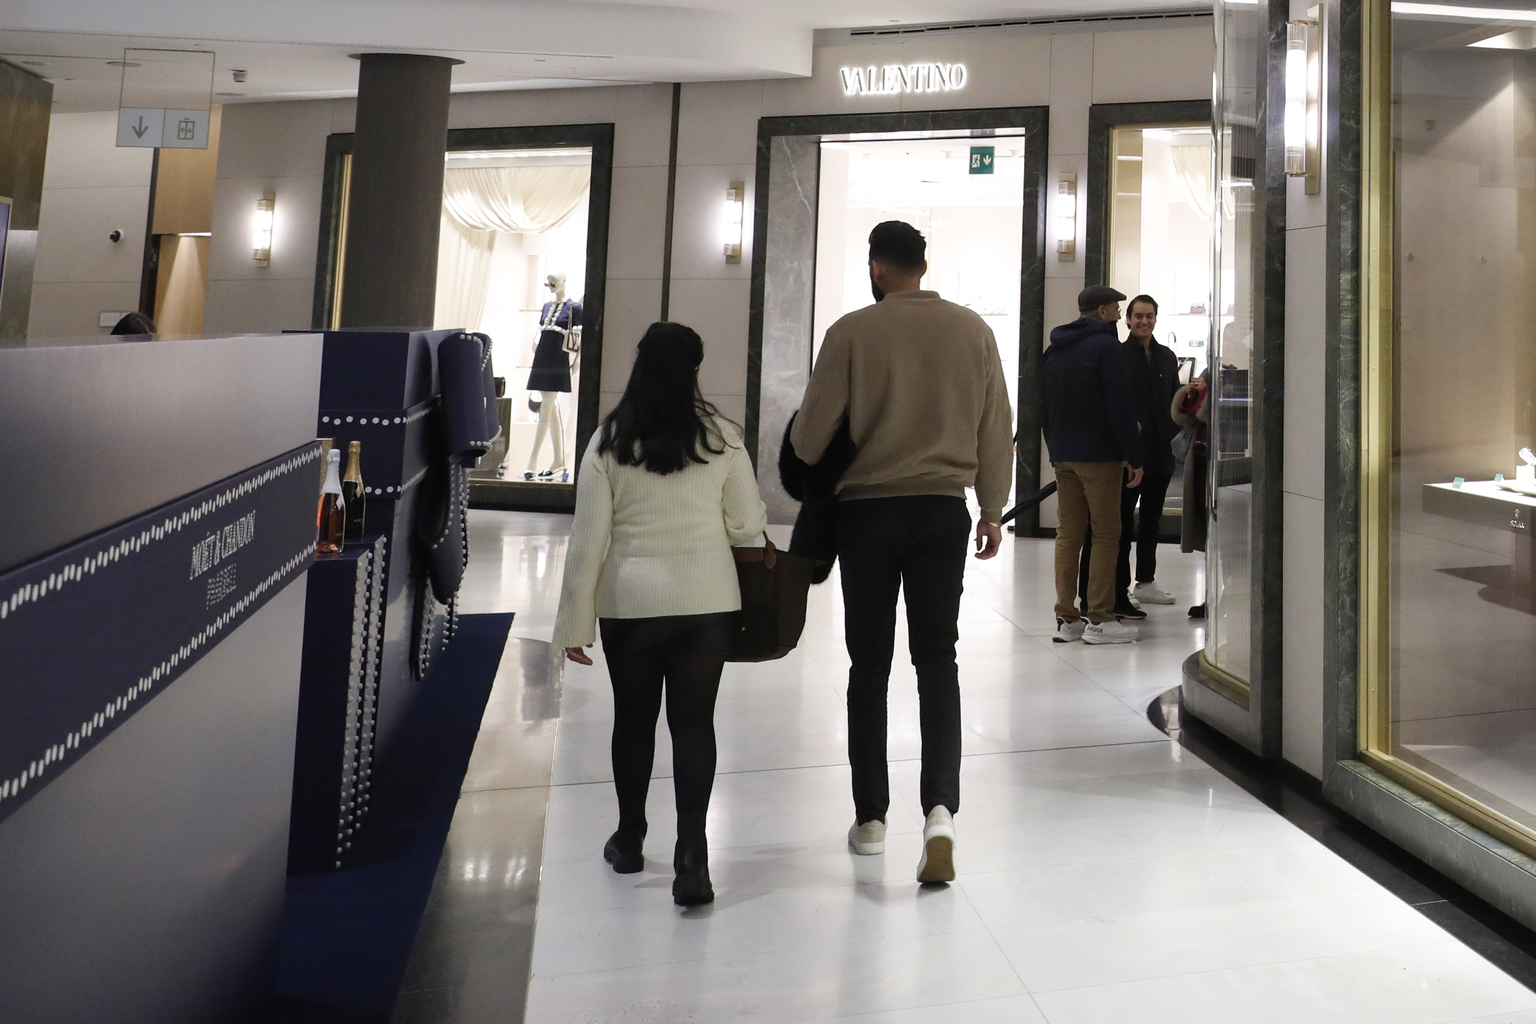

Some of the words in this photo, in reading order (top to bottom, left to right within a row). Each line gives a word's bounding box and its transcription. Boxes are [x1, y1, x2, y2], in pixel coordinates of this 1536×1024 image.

[839, 63, 968, 95] VALENTINO
[214, 530, 222, 566] &
[221, 509, 256, 559] CHANDON
